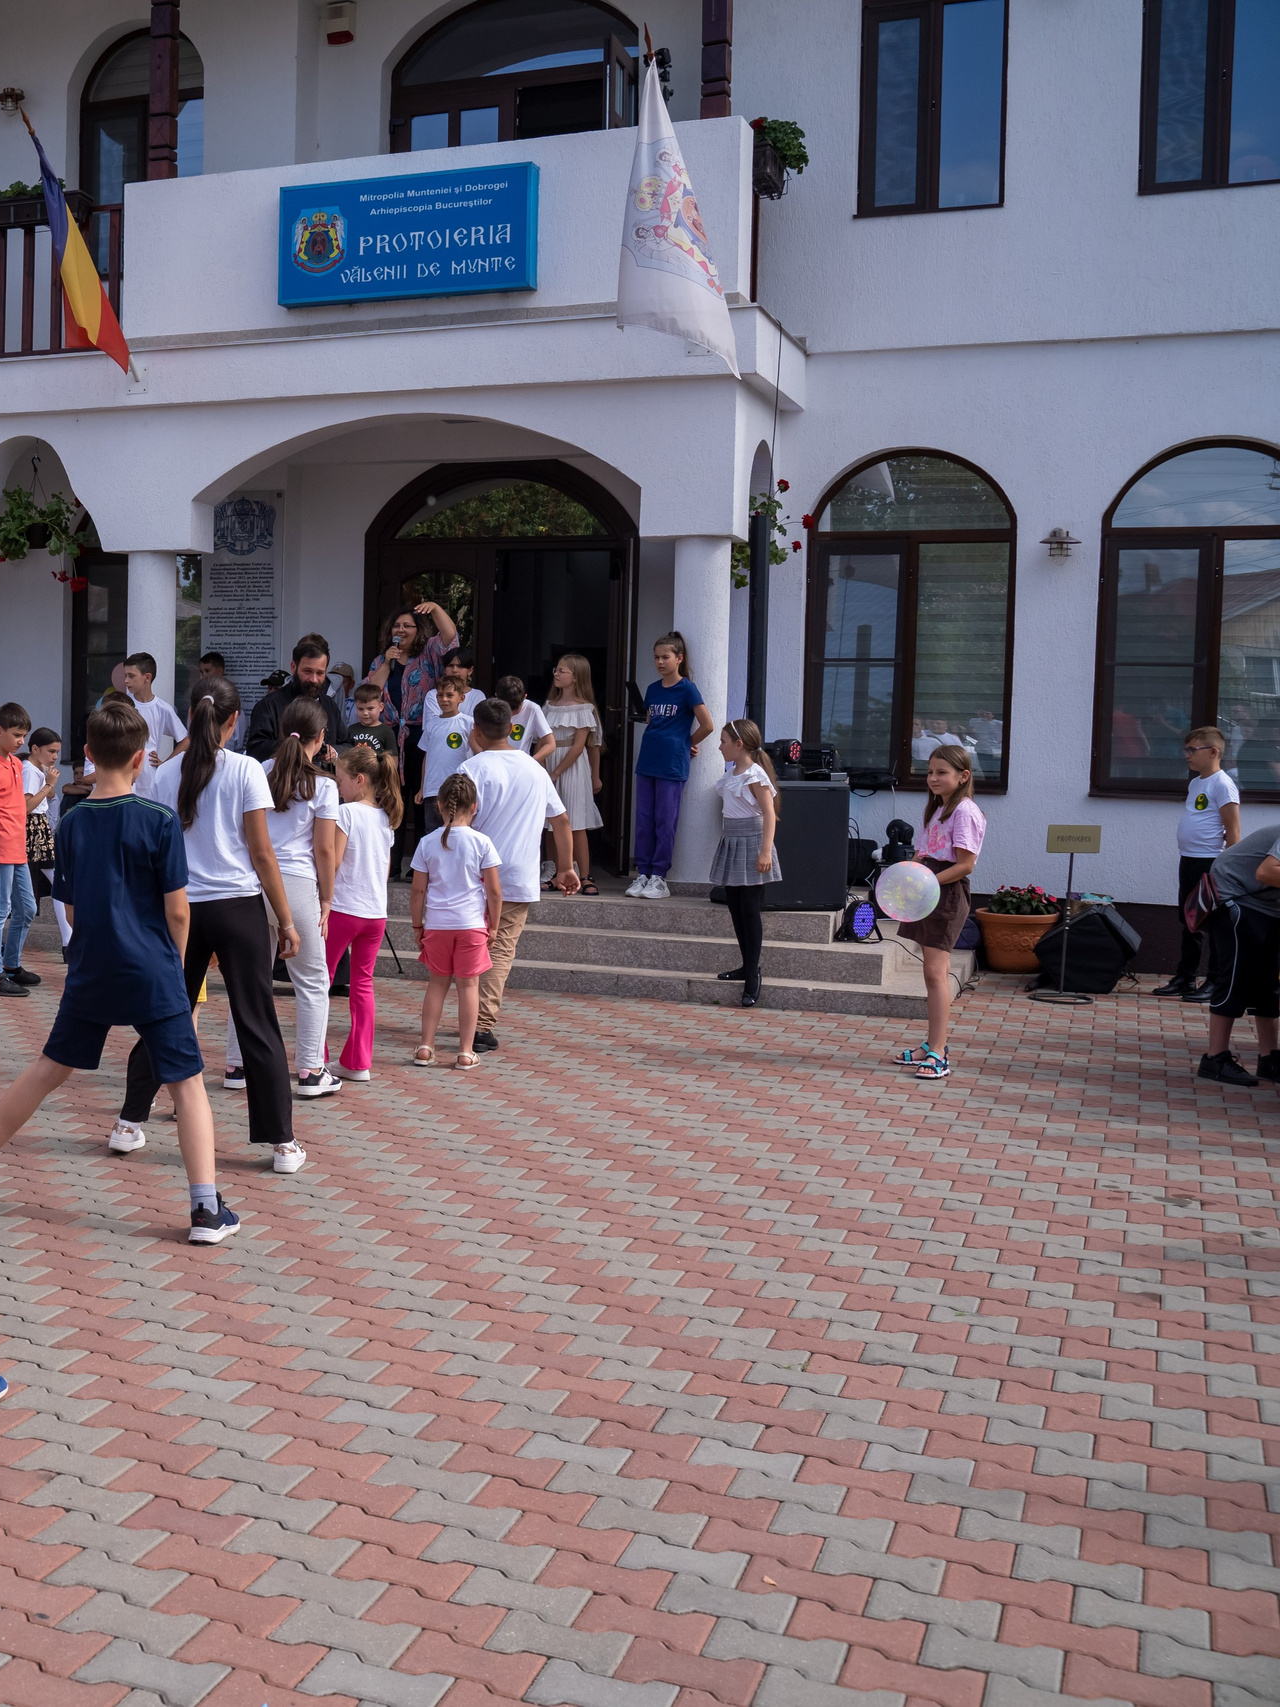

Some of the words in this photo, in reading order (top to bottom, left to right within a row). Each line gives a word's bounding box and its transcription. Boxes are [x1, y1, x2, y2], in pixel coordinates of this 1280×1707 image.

[359, 191, 405, 202] Mitropolia
[407, 186, 452, 197] Munteniei
[465, 181, 508, 192] Dobrogei
[370, 203, 433, 216] Arhiepiscopia
[358, 223, 511, 256] PROTOIERIA
[340, 264, 407, 284] VĂLENII
[417, 261, 441, 278] DE
